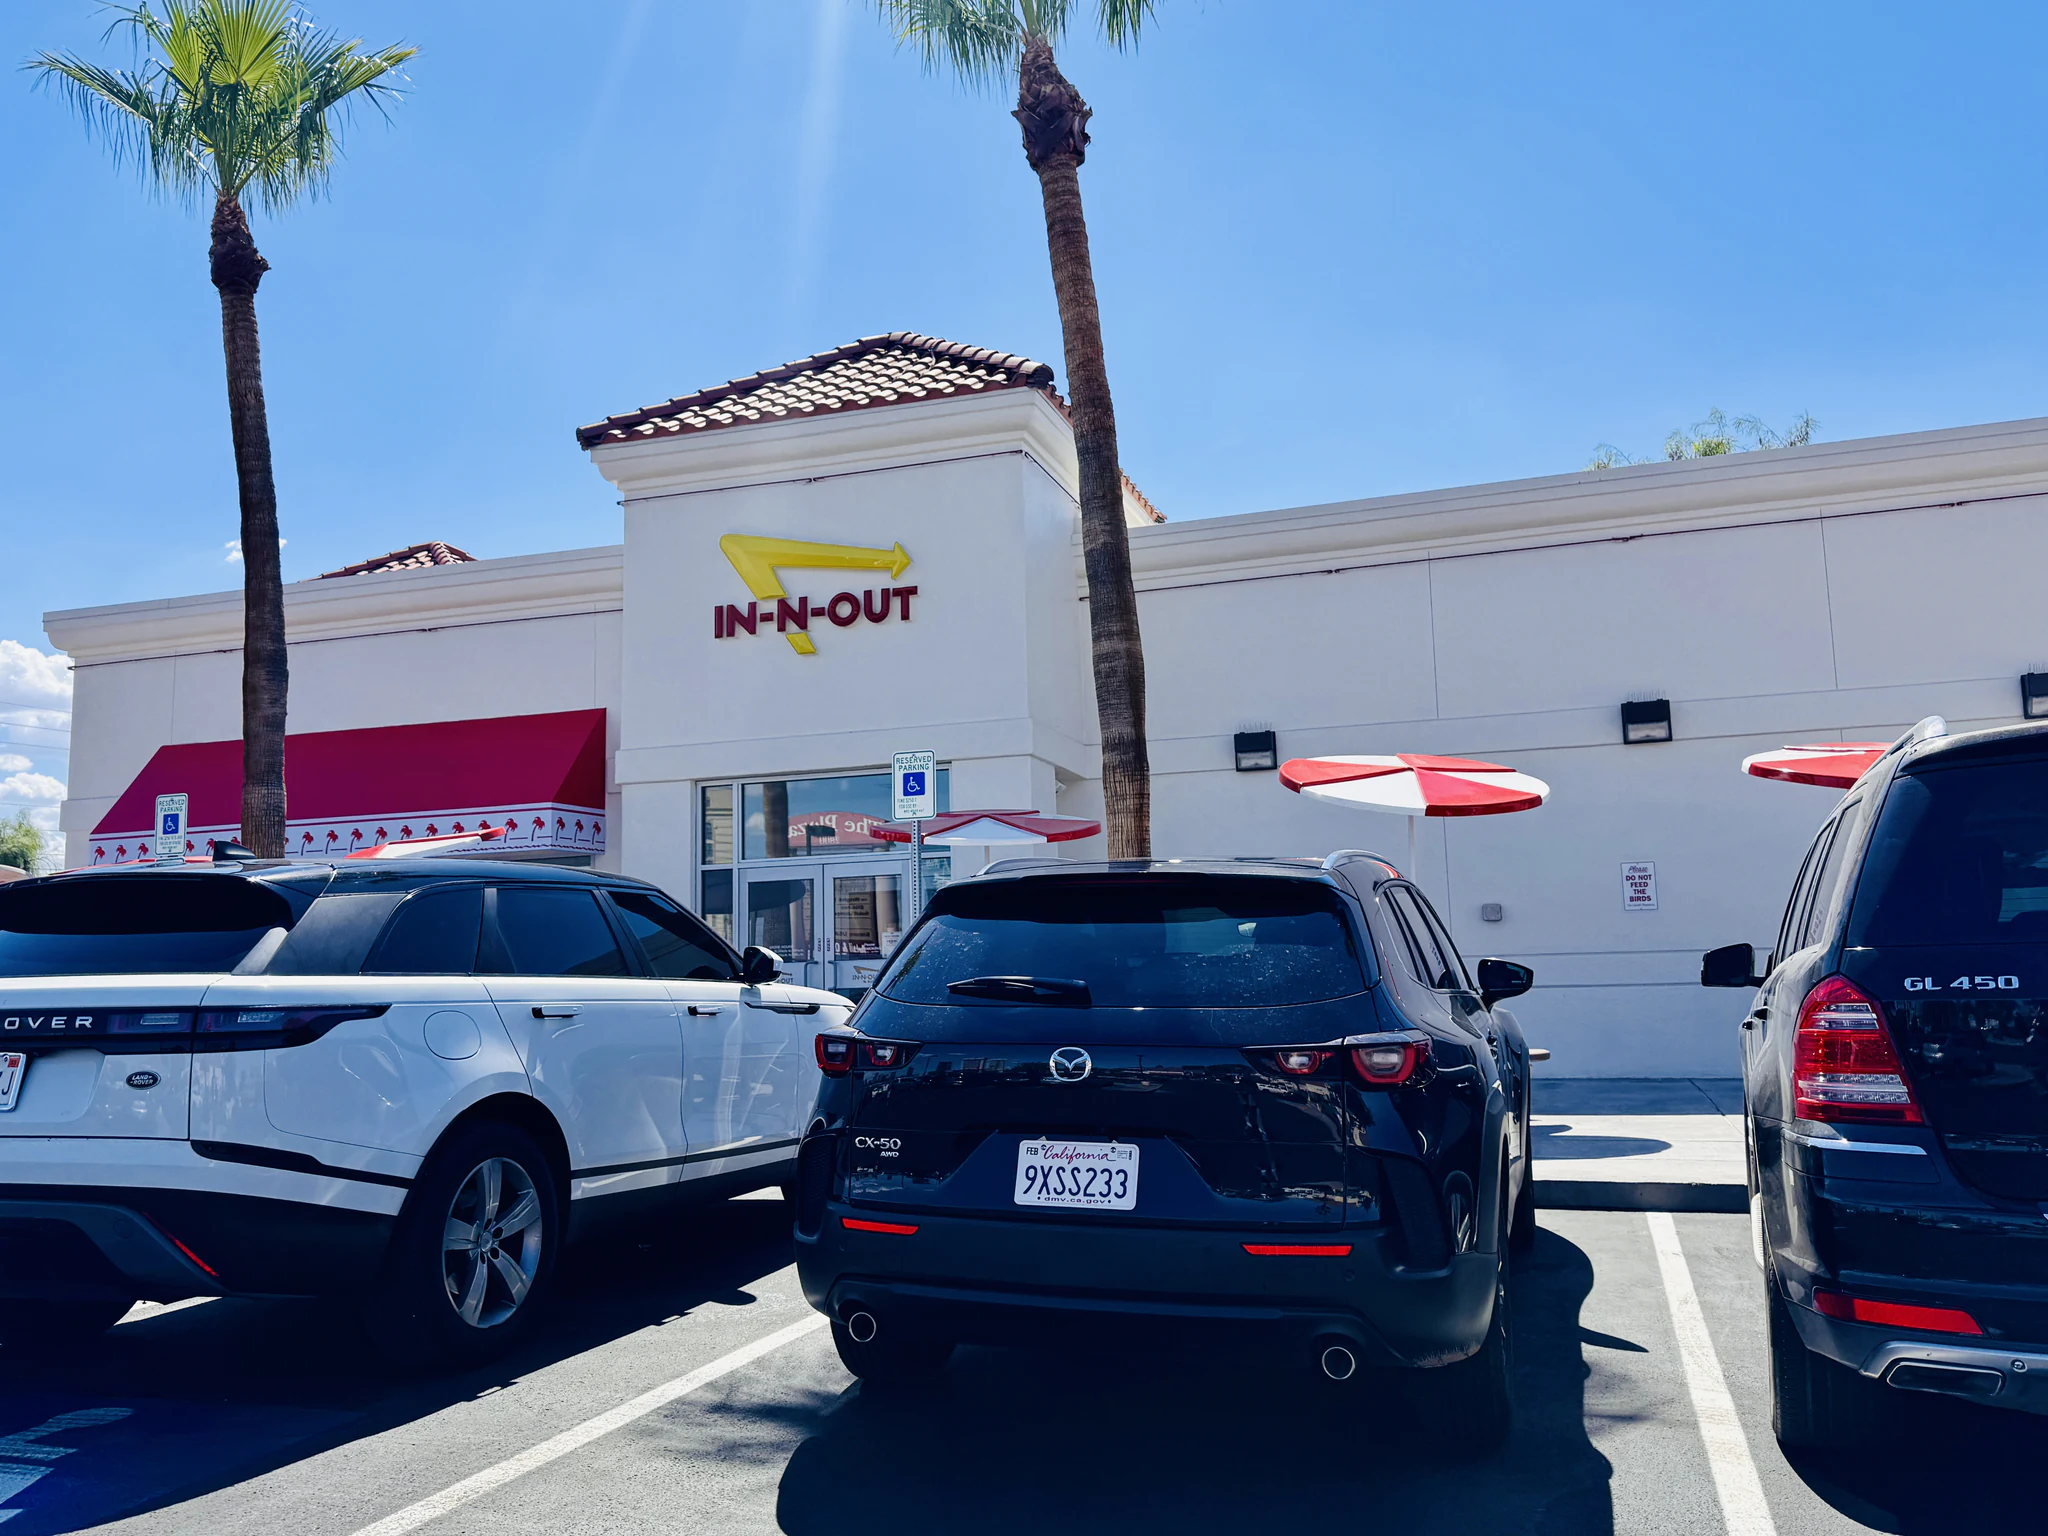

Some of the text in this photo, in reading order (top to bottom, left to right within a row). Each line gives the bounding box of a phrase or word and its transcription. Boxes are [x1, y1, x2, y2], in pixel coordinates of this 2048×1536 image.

[714, 585, 918, 639] IN-N-OUT
[896, 756, 931, 764] RESERVED
[898, 763, 930, 771] PARKING
[159, 799, 184, 807] RESERVED
[1628, 865, 1649, 874] Please
[1904, 975, 2020, 991] GL 450
[4, 1016, 93, 1030] OVER
[855, 1136, 902, 1150] CX-50
[1026, 1146, 1039, 1156] FEB
[1043, 1145, 1116, 1165] California
[1023, 1164, 1128, 1199] 9XSS233
[1044, 1196, 1107, 1204] dmv.ca.gov
